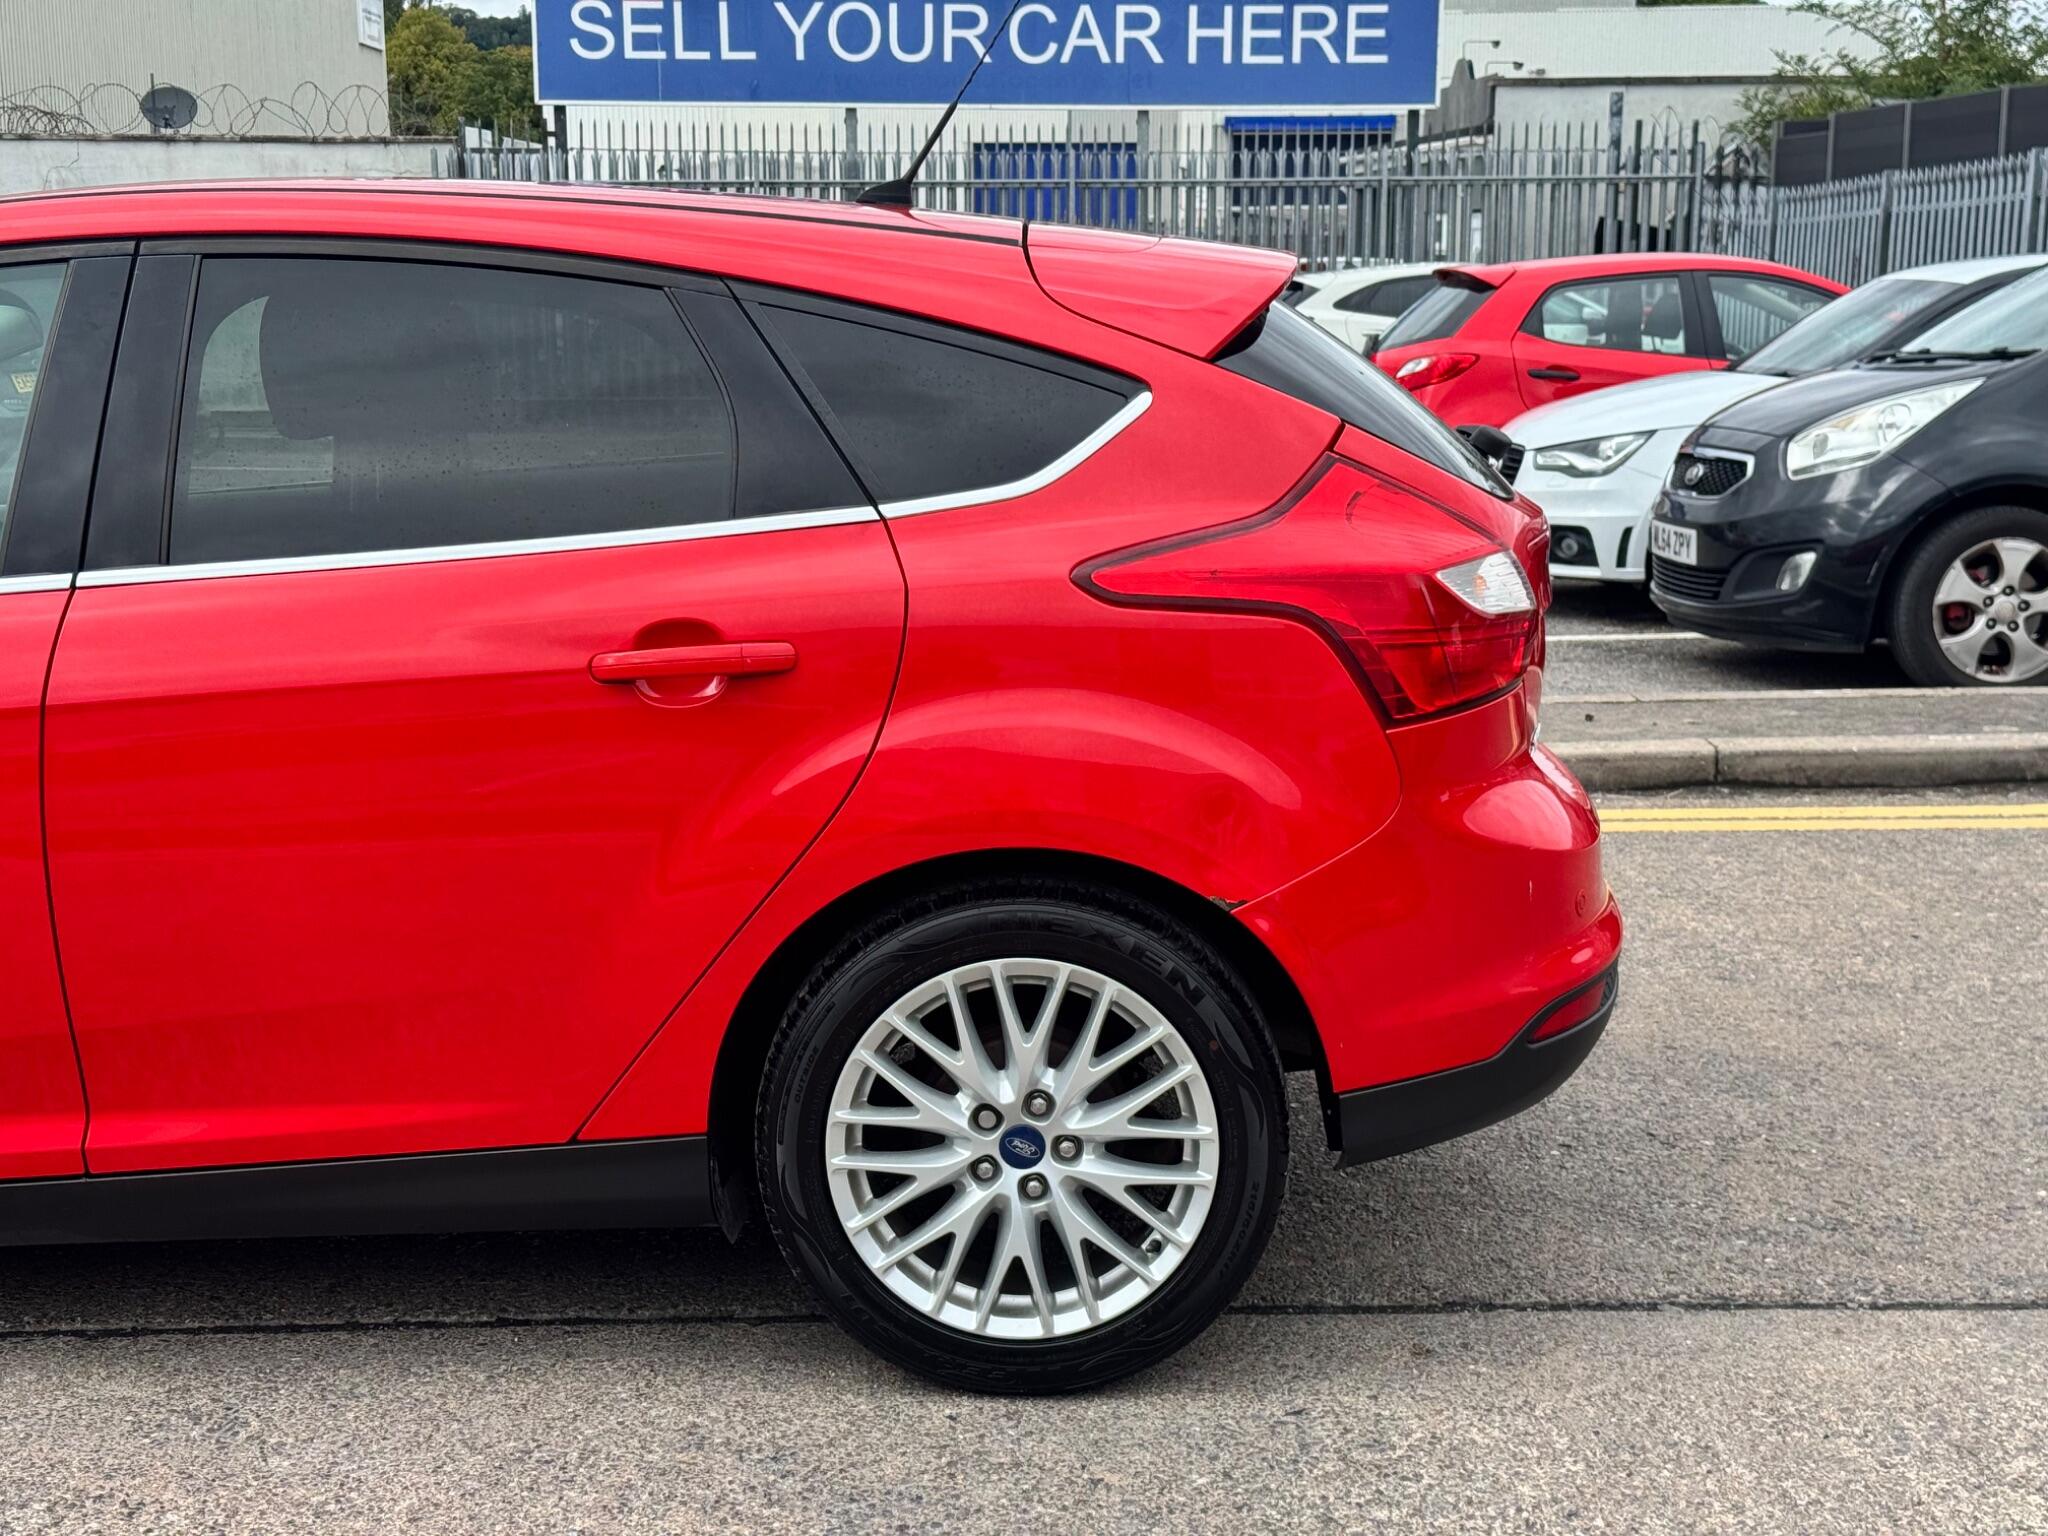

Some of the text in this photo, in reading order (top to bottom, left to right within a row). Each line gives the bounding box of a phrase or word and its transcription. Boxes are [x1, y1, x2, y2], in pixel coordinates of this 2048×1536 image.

[569, 0, 1389, 65] SELL YOUR CAR HERE
